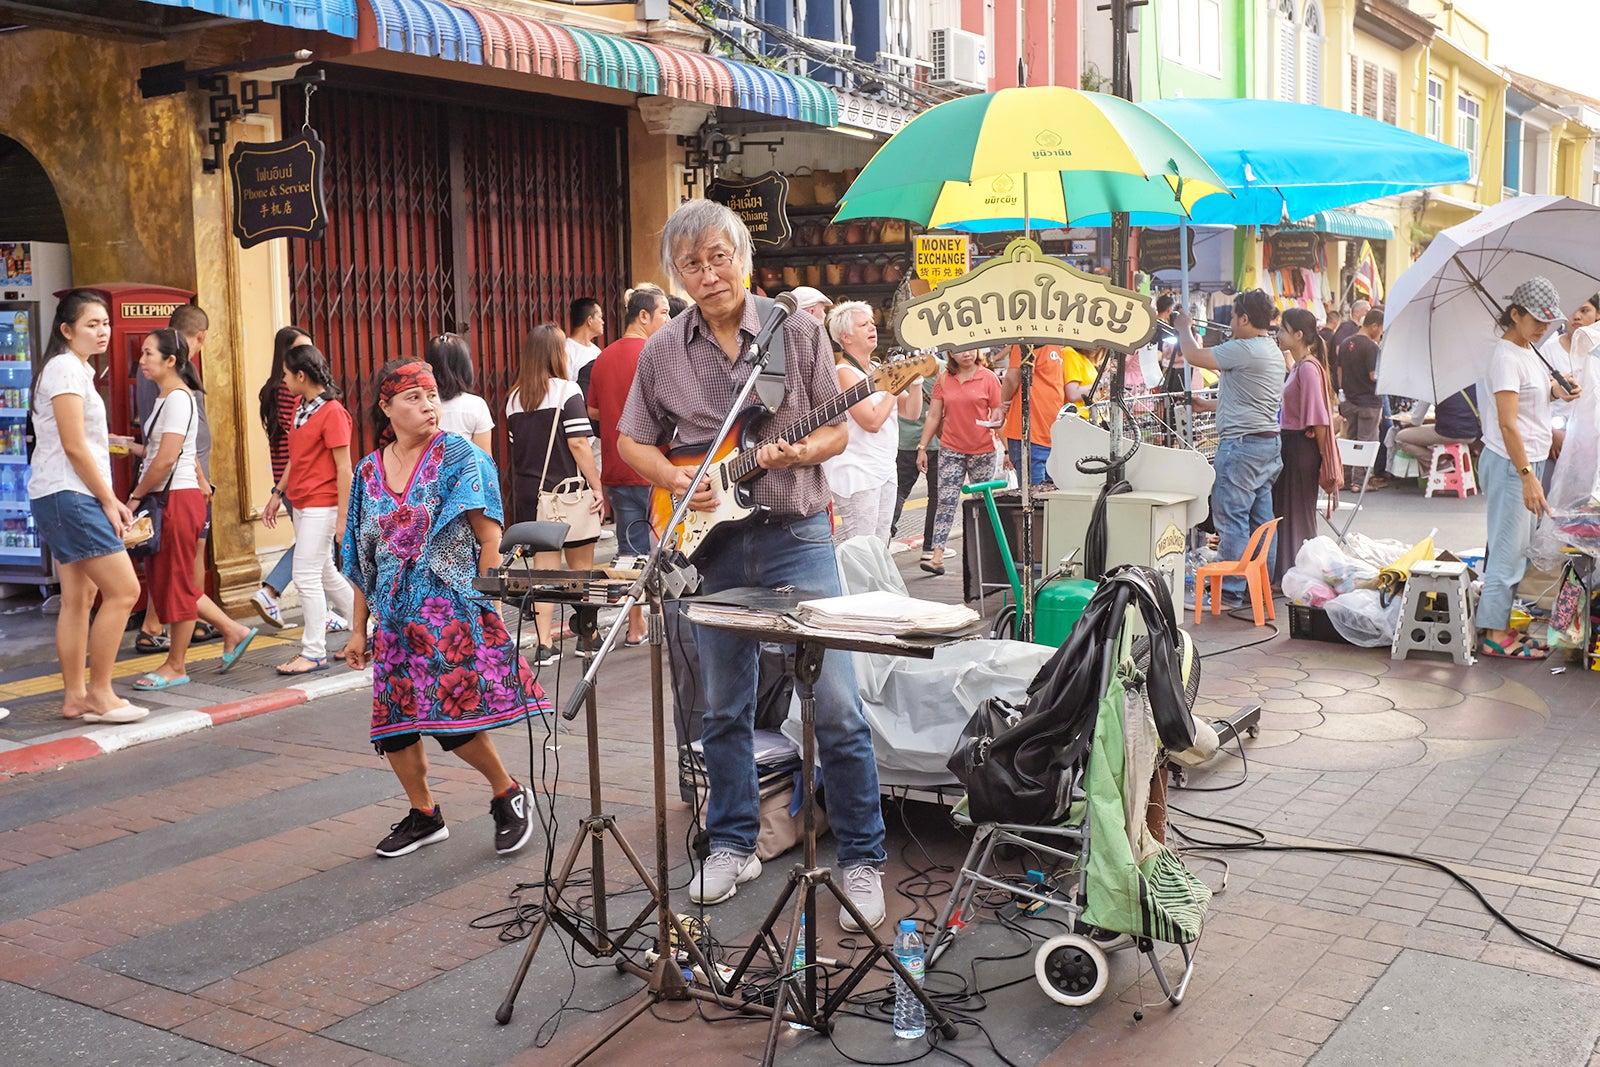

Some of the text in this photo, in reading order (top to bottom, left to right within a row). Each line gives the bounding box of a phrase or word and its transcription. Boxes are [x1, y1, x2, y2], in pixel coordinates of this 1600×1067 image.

[243, 181, 310, 200] Phone & Service
[260, 200, 293, 218] 手机店
[741, 210, 769, 222] Shiang
[922, 239, 961, 251] MONEY
[918, 253, 965, 265] EXCHANGE
[124, 304, 179, 316] TELEPHON
[917, 272, 1134, 336] หลาดใหญ่
